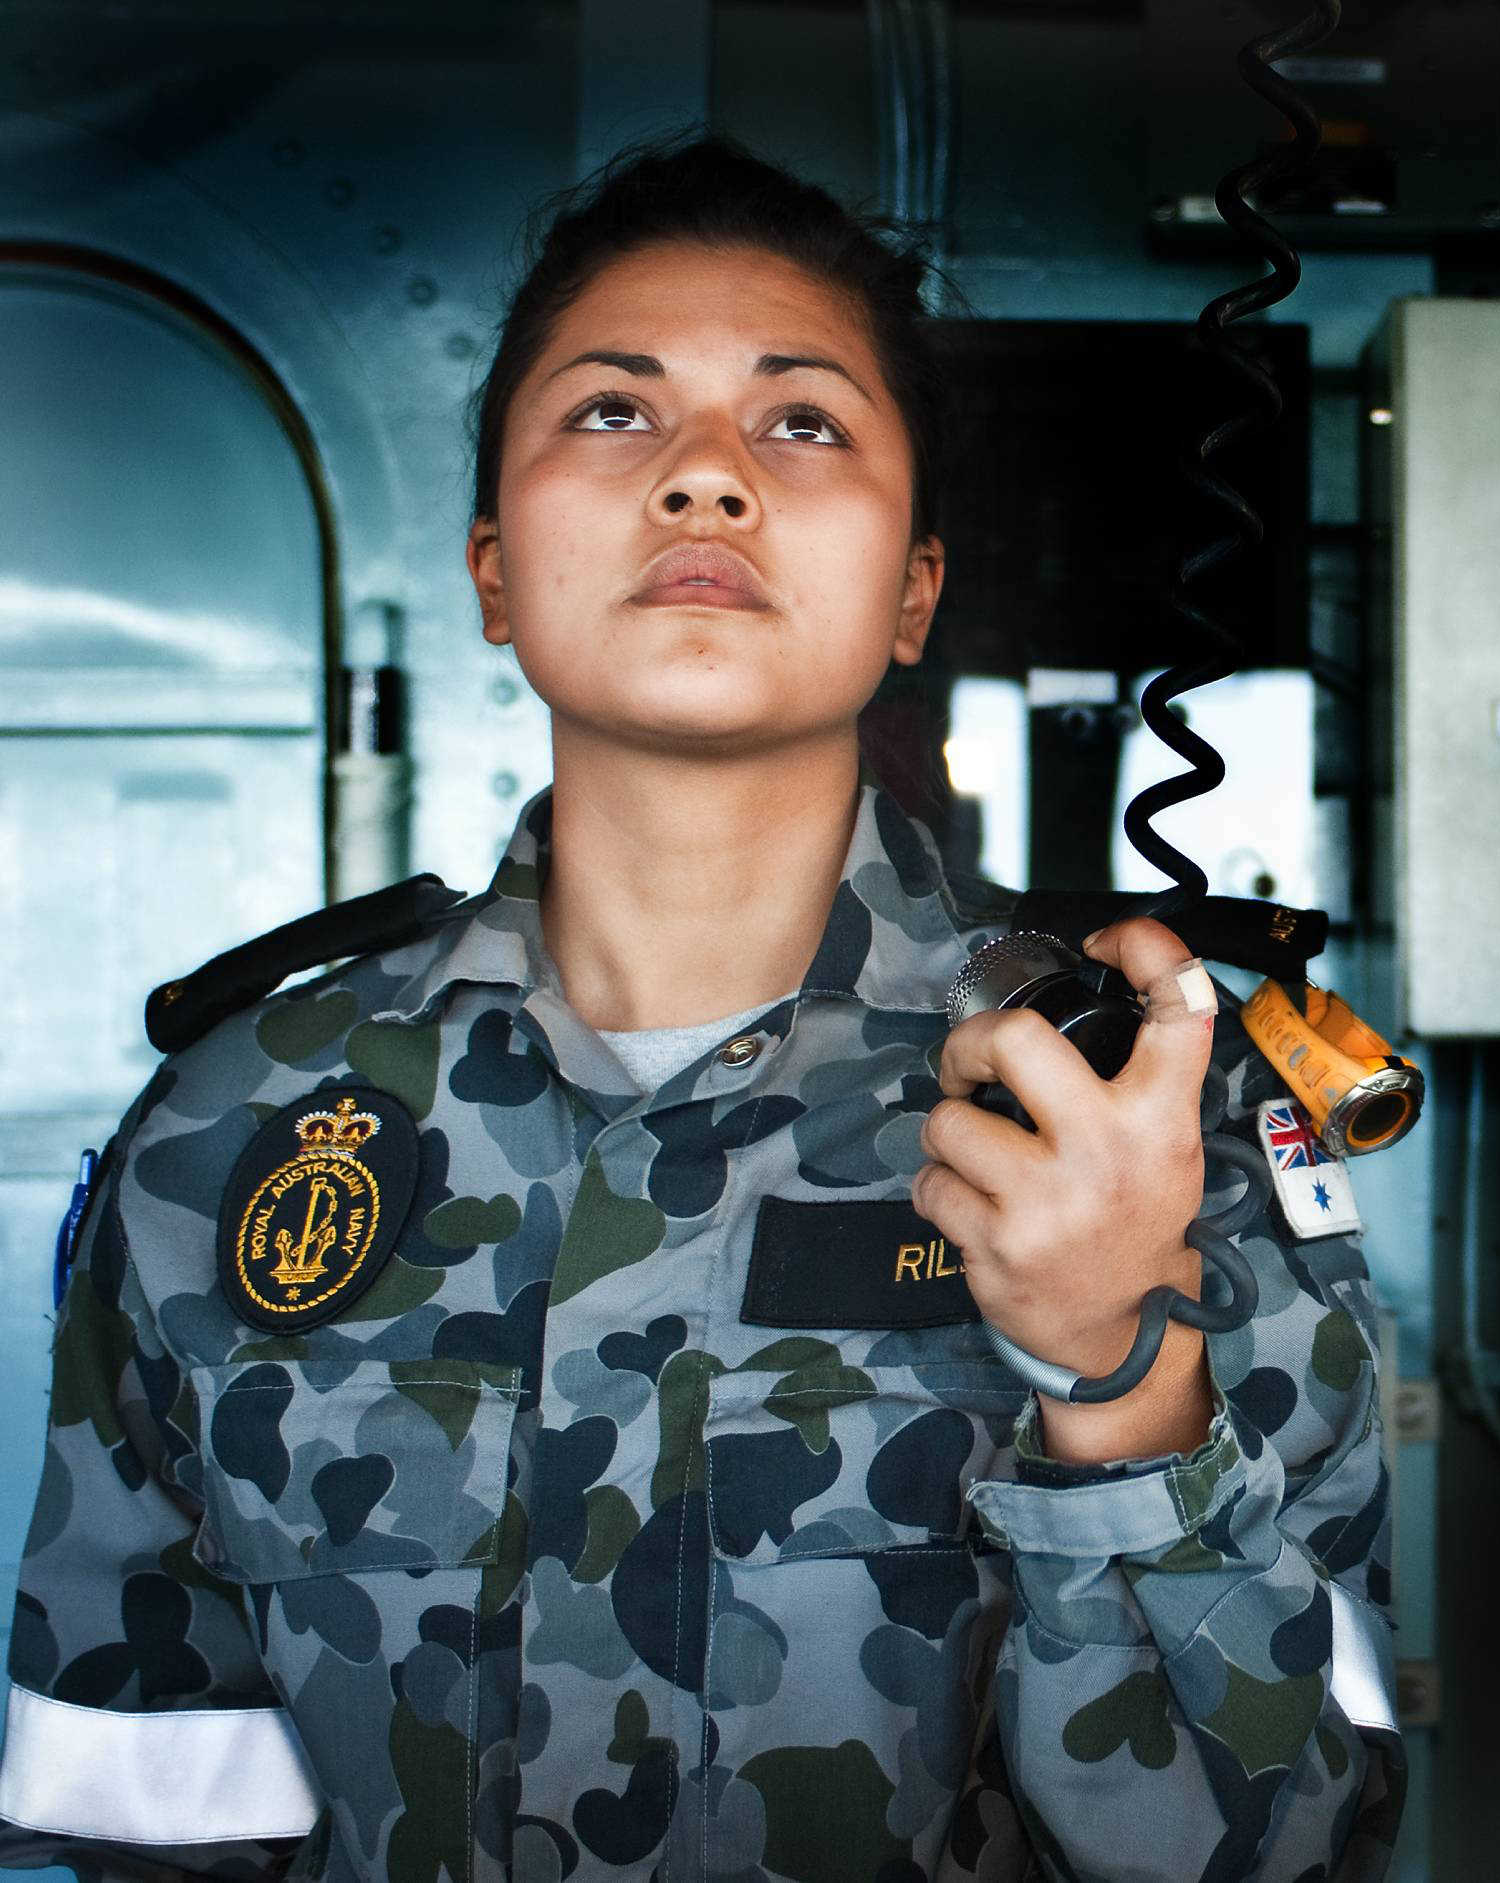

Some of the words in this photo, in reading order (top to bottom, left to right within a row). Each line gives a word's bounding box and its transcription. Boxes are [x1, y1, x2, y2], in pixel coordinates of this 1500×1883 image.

[251, 1203, 277, 1261] ROYAL
[270, 1160, 366, 1200] AUSTRALIAN
[341, 1206, 366, 1256] NAVY
[894, 1238, 969, 1282] RIL
